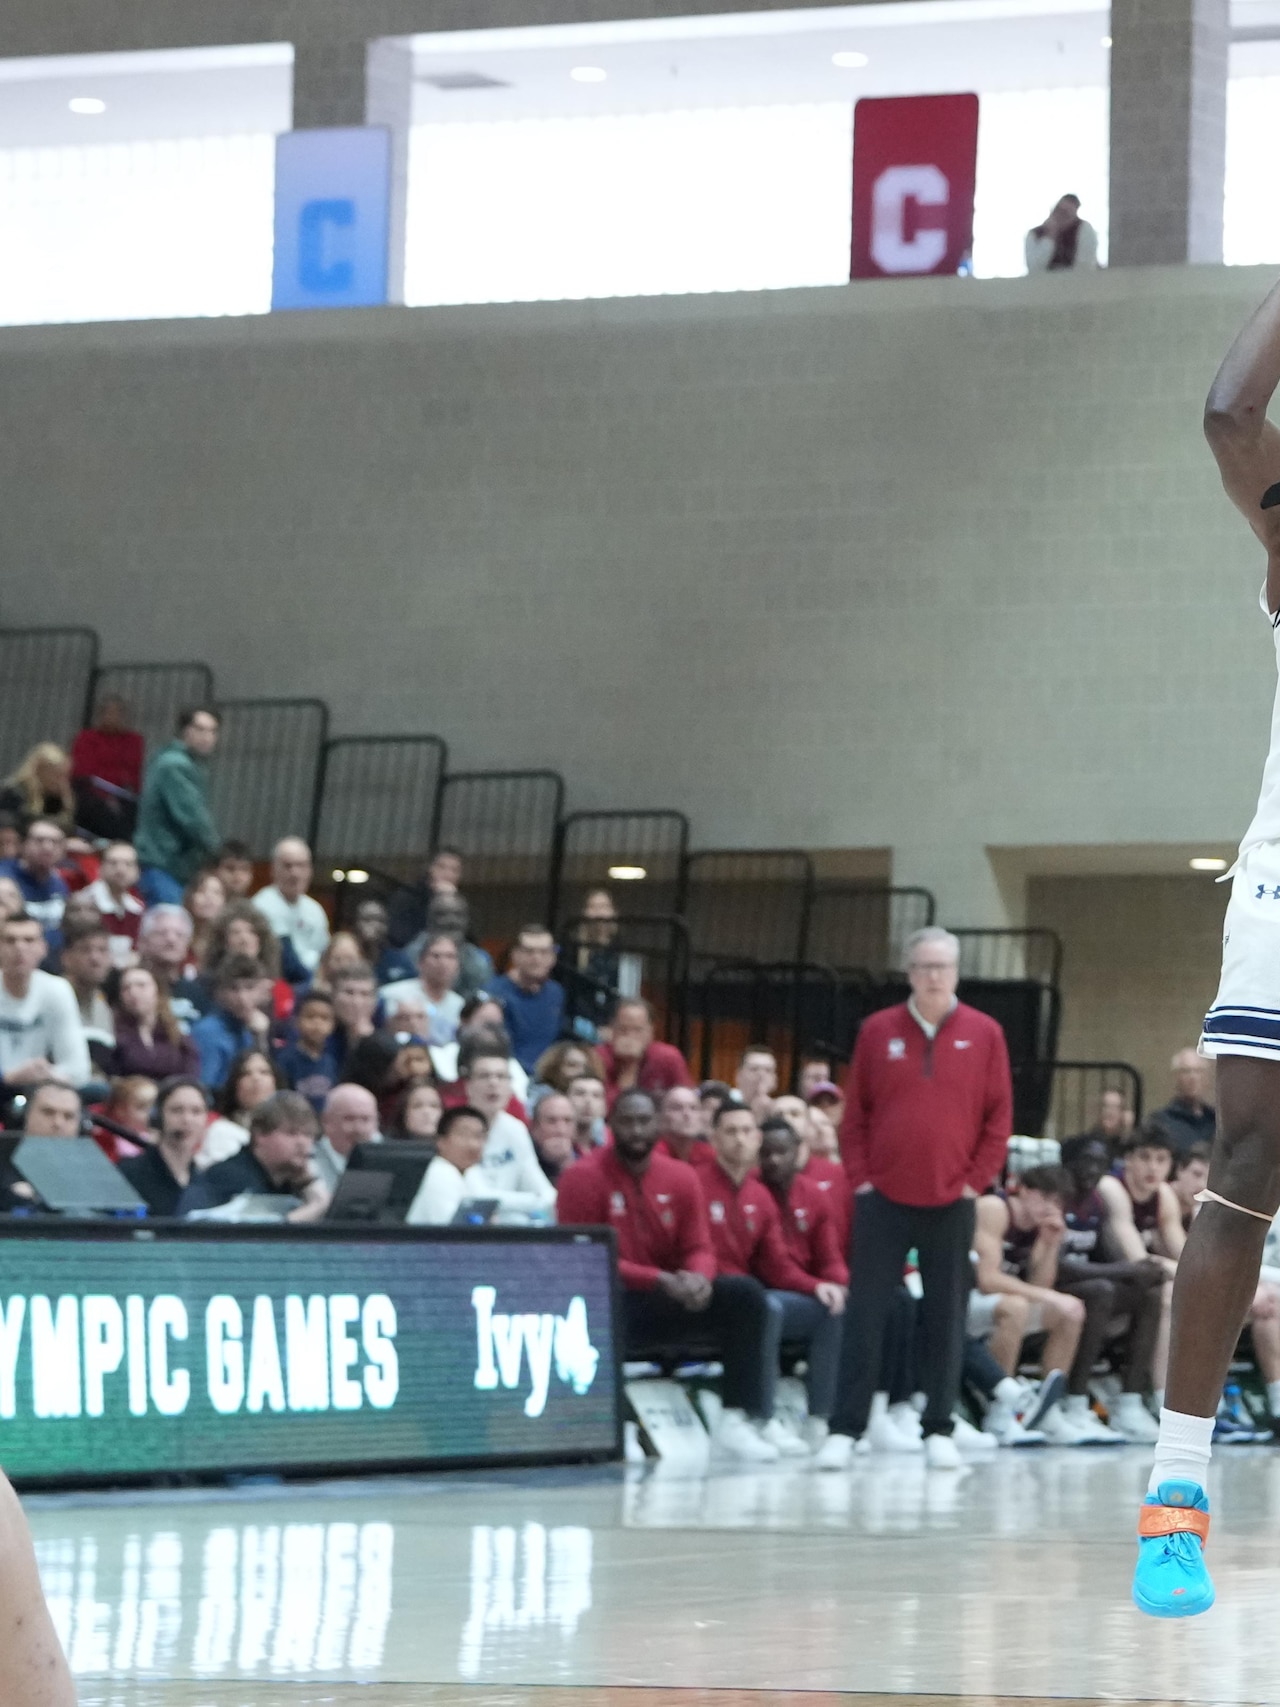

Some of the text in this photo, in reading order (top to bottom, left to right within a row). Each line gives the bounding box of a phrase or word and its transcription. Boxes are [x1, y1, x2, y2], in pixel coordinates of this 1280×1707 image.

[298, 198, 355, 293] C
[870, 164, 949, 274] C
[206, 1293, 399, 1414] GAMES
[471, 1285, 554, 1418] Ivy
